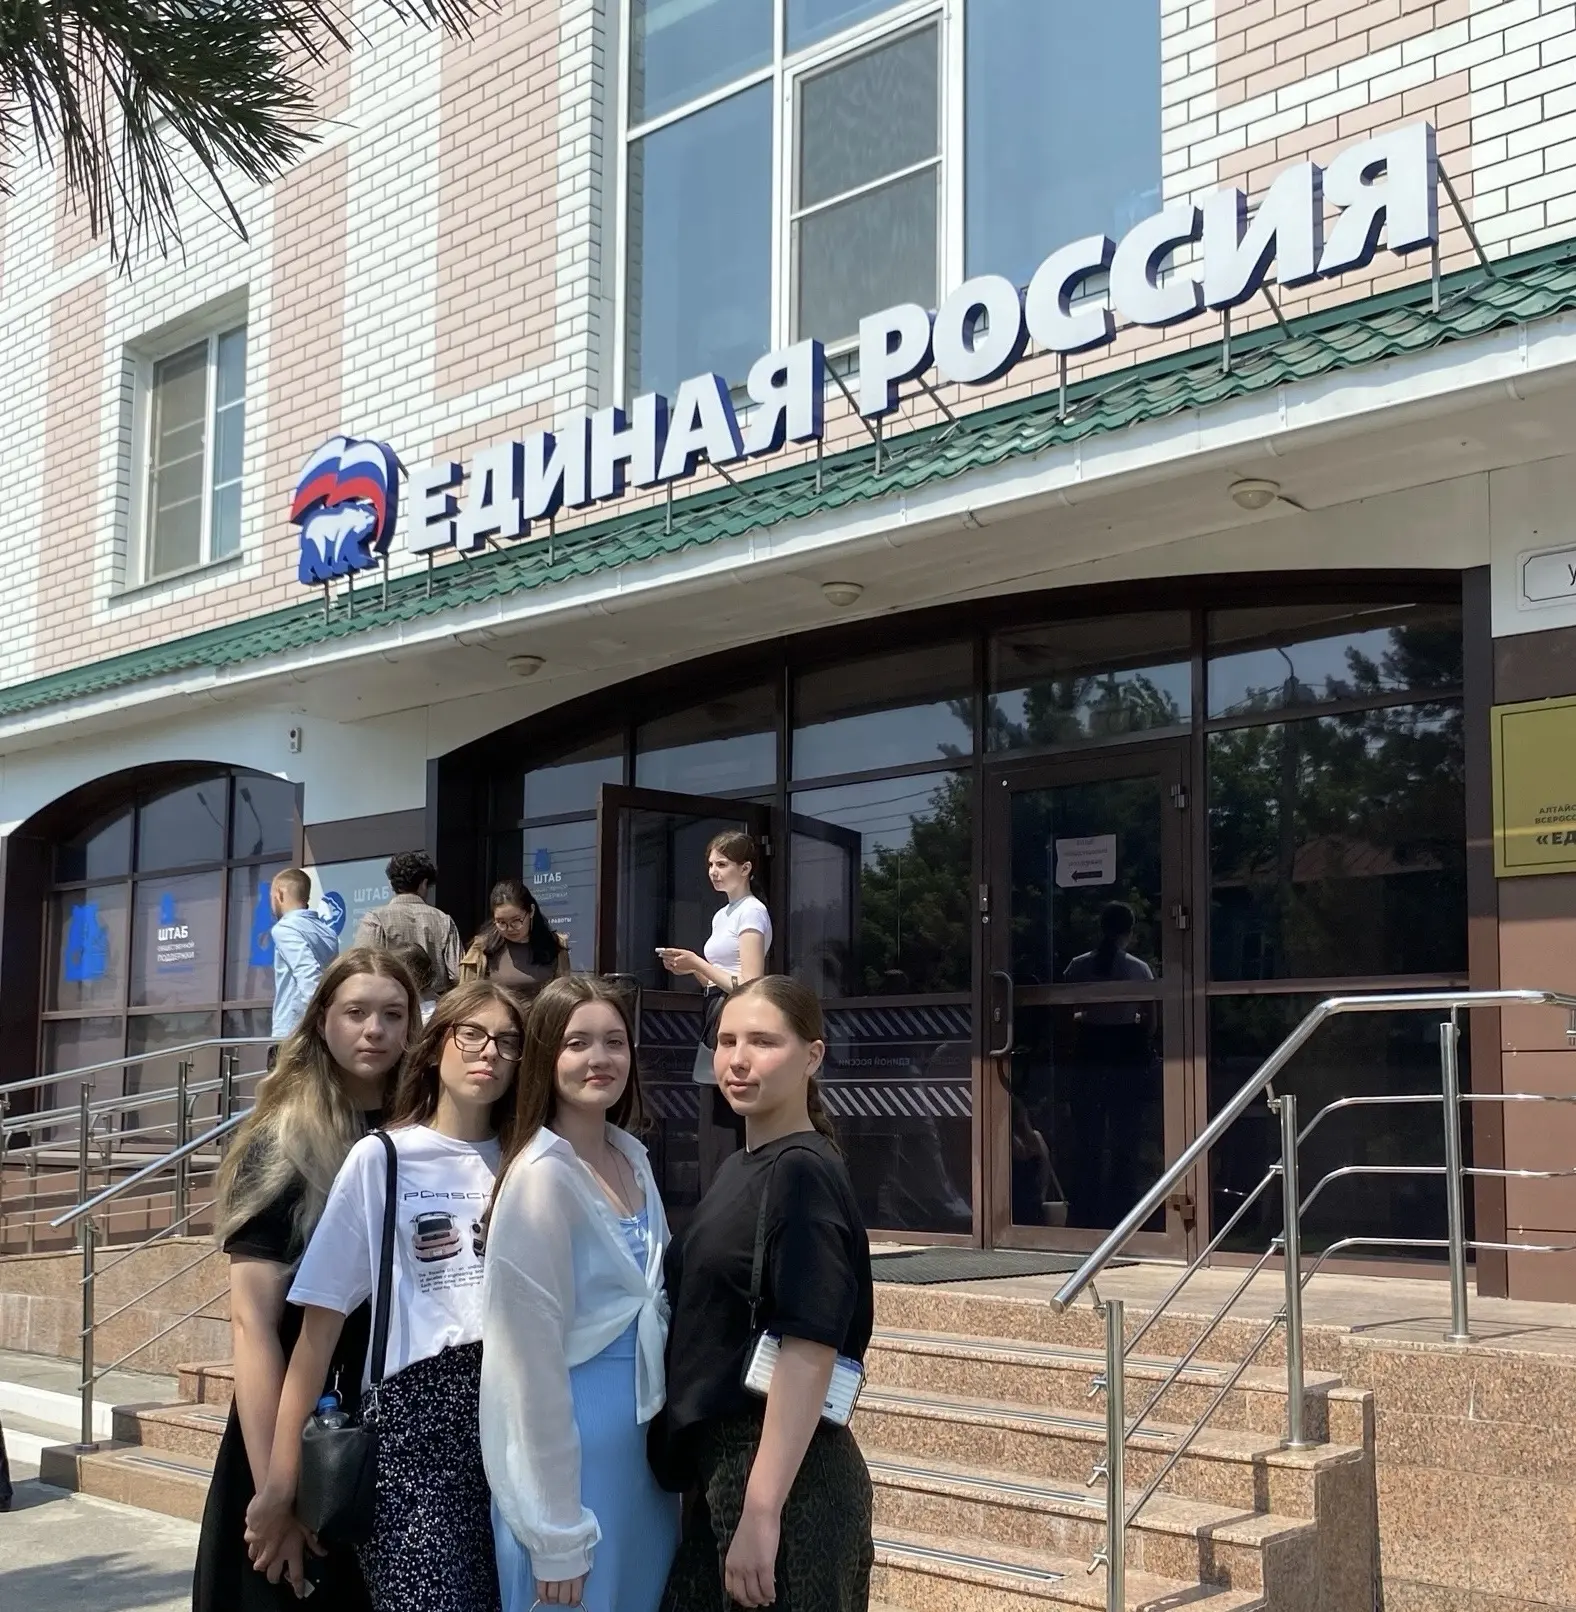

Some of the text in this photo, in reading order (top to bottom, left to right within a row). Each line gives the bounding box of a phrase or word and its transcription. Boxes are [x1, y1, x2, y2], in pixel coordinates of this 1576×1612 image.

[406, 120, 1438, 554] ЕДИНАЯ РОССИЯ
[534, 872, 562, 885] ШТАБ
[353, 886, 390, 902] ШТАБ
[158, 925, 189, 941] ШТАБ
